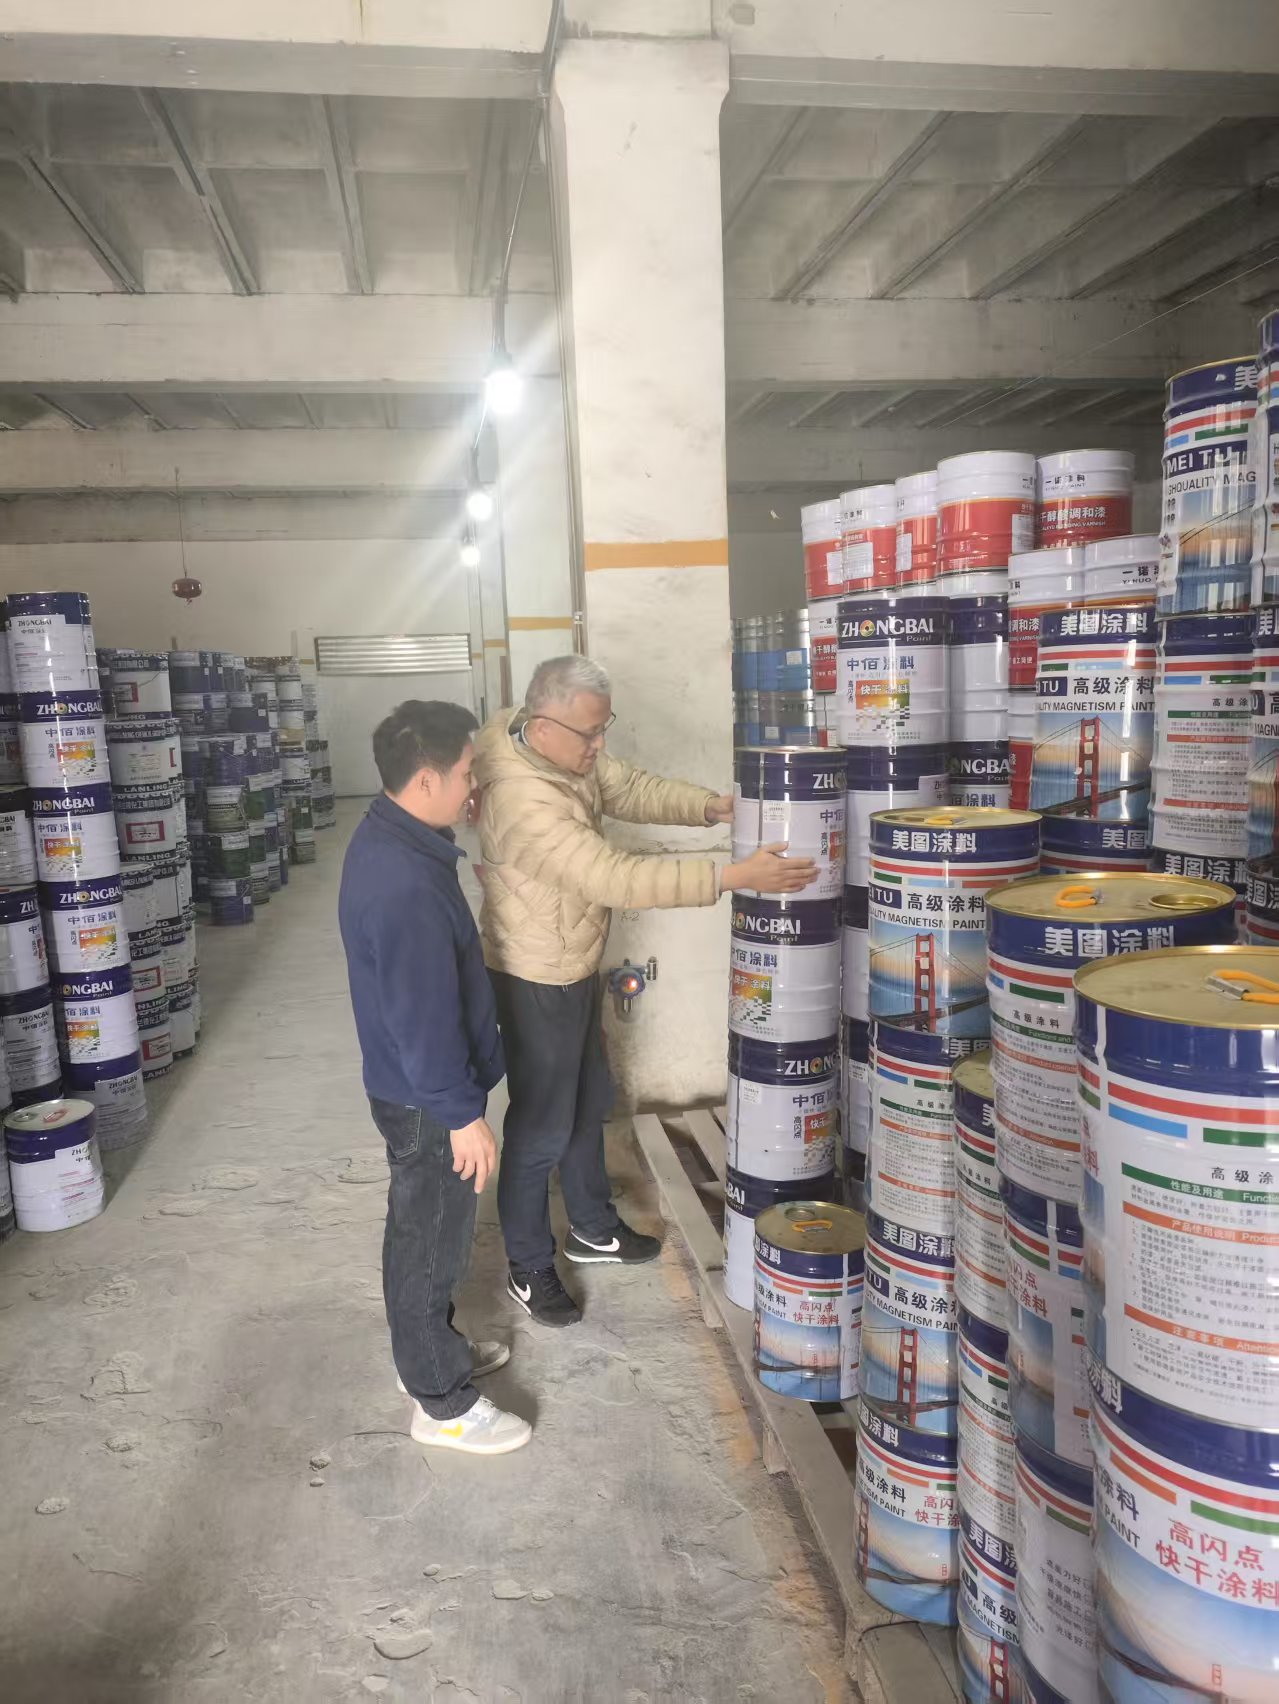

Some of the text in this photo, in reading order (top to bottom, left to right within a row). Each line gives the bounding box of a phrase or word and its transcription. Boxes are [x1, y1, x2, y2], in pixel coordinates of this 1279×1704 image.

[1167, 446, 1233, 474] MEI TU
[841, 618, 934, 638] ZHONGBAI
[846, 656, 915, 672] 中佰涂料
[1052, 701, 1116, 711] MAGNETISM
[32, 797, 95, 812] ZHONGBAI
[892, 829, 977, 853] 美图涂料
[907, 893, 985, 914] 高级涂料
[953, 919, 986, 929] PAINT
[1045, 925, 1175, 958] 美图涂料
[1210, 1166, 1275, 1185] 高级涂
[1170, 1180, 1224, 1200] 性能及用途
[798, 1299, 835, 1313] 高闪点
[876, 1297, 932, 1328] MAGNETISM
[792, 1311, 840, 1326] 快干涂料
[879, 1497, 907, 1518] PAINT
[1104, 1502, 1279, 1608] PAINT 快干涂料
[1168, 1518, 1264, 1573] 高闪点
